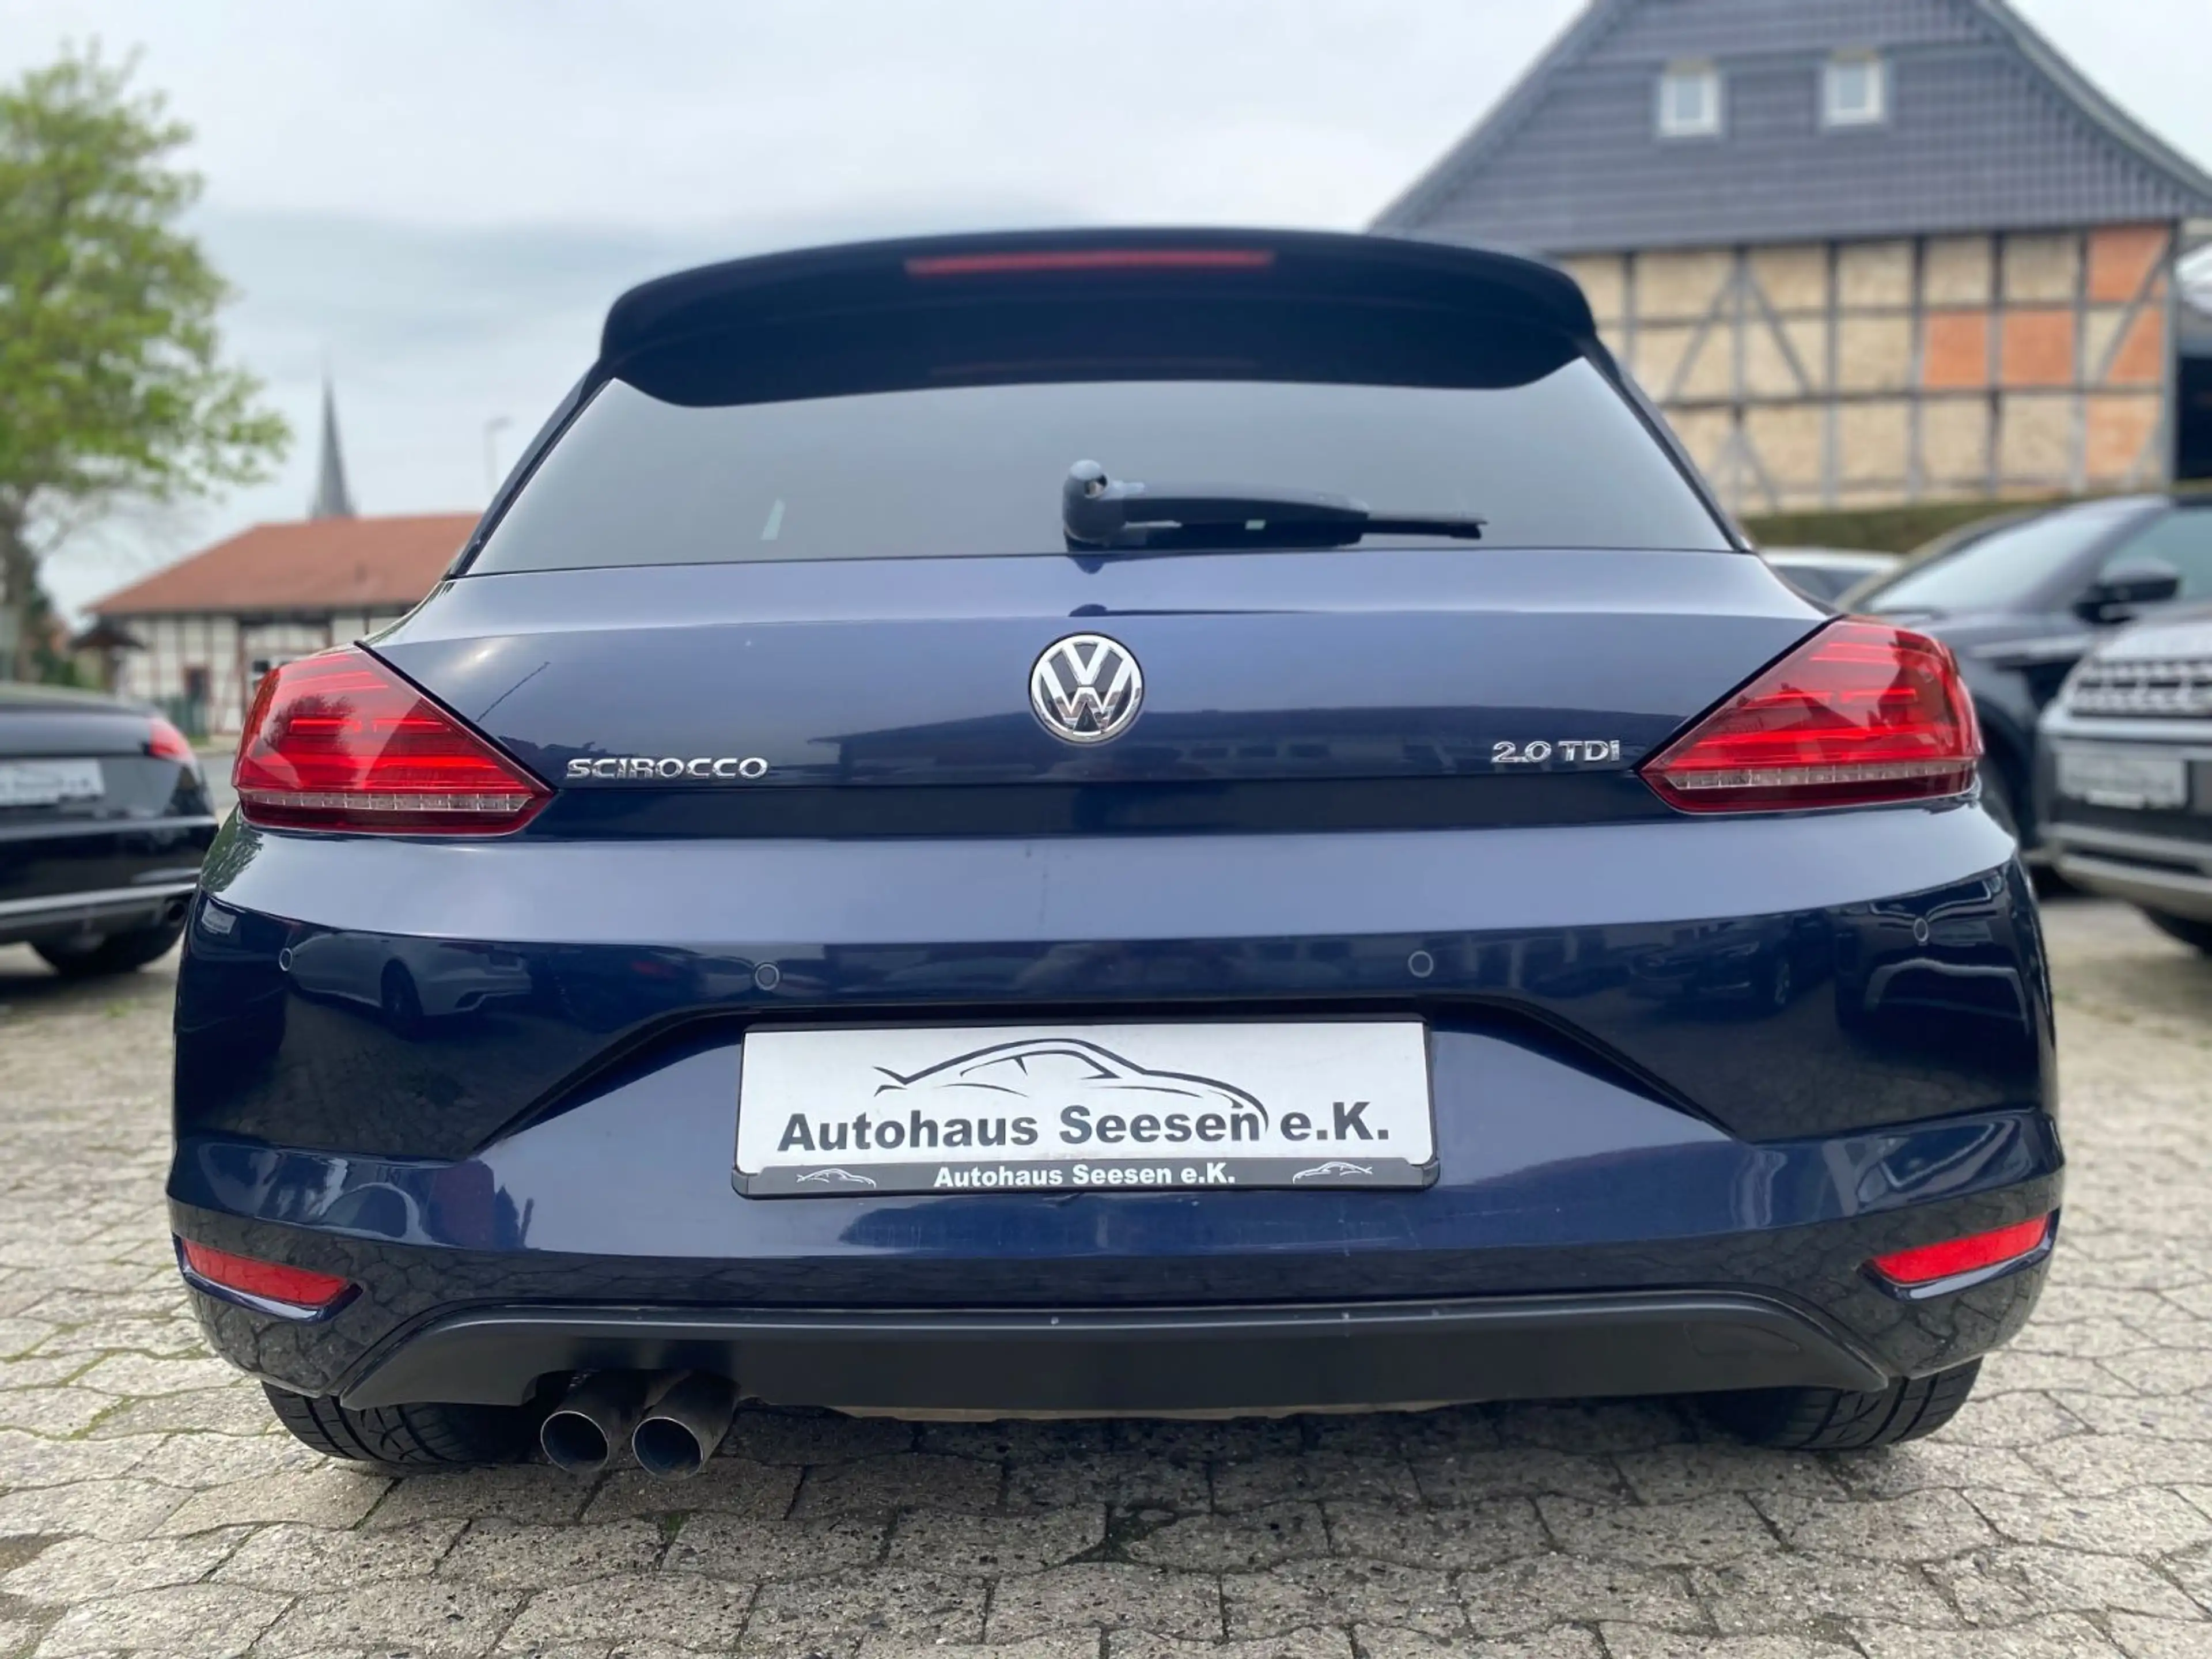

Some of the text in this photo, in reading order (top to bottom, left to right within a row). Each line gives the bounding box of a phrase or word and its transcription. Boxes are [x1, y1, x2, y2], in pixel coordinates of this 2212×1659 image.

[1035, 637, 1137, 734] VW
[1491, 740, 1620, 763] 2.0 TDI
[566, 757, 768, 779] SCIROCCO
[777, 1101, 1389, 1152] Autohaus Seesen e.K.
[934, 1162, 1236, 1188] Autohaus Seesen e.K.
